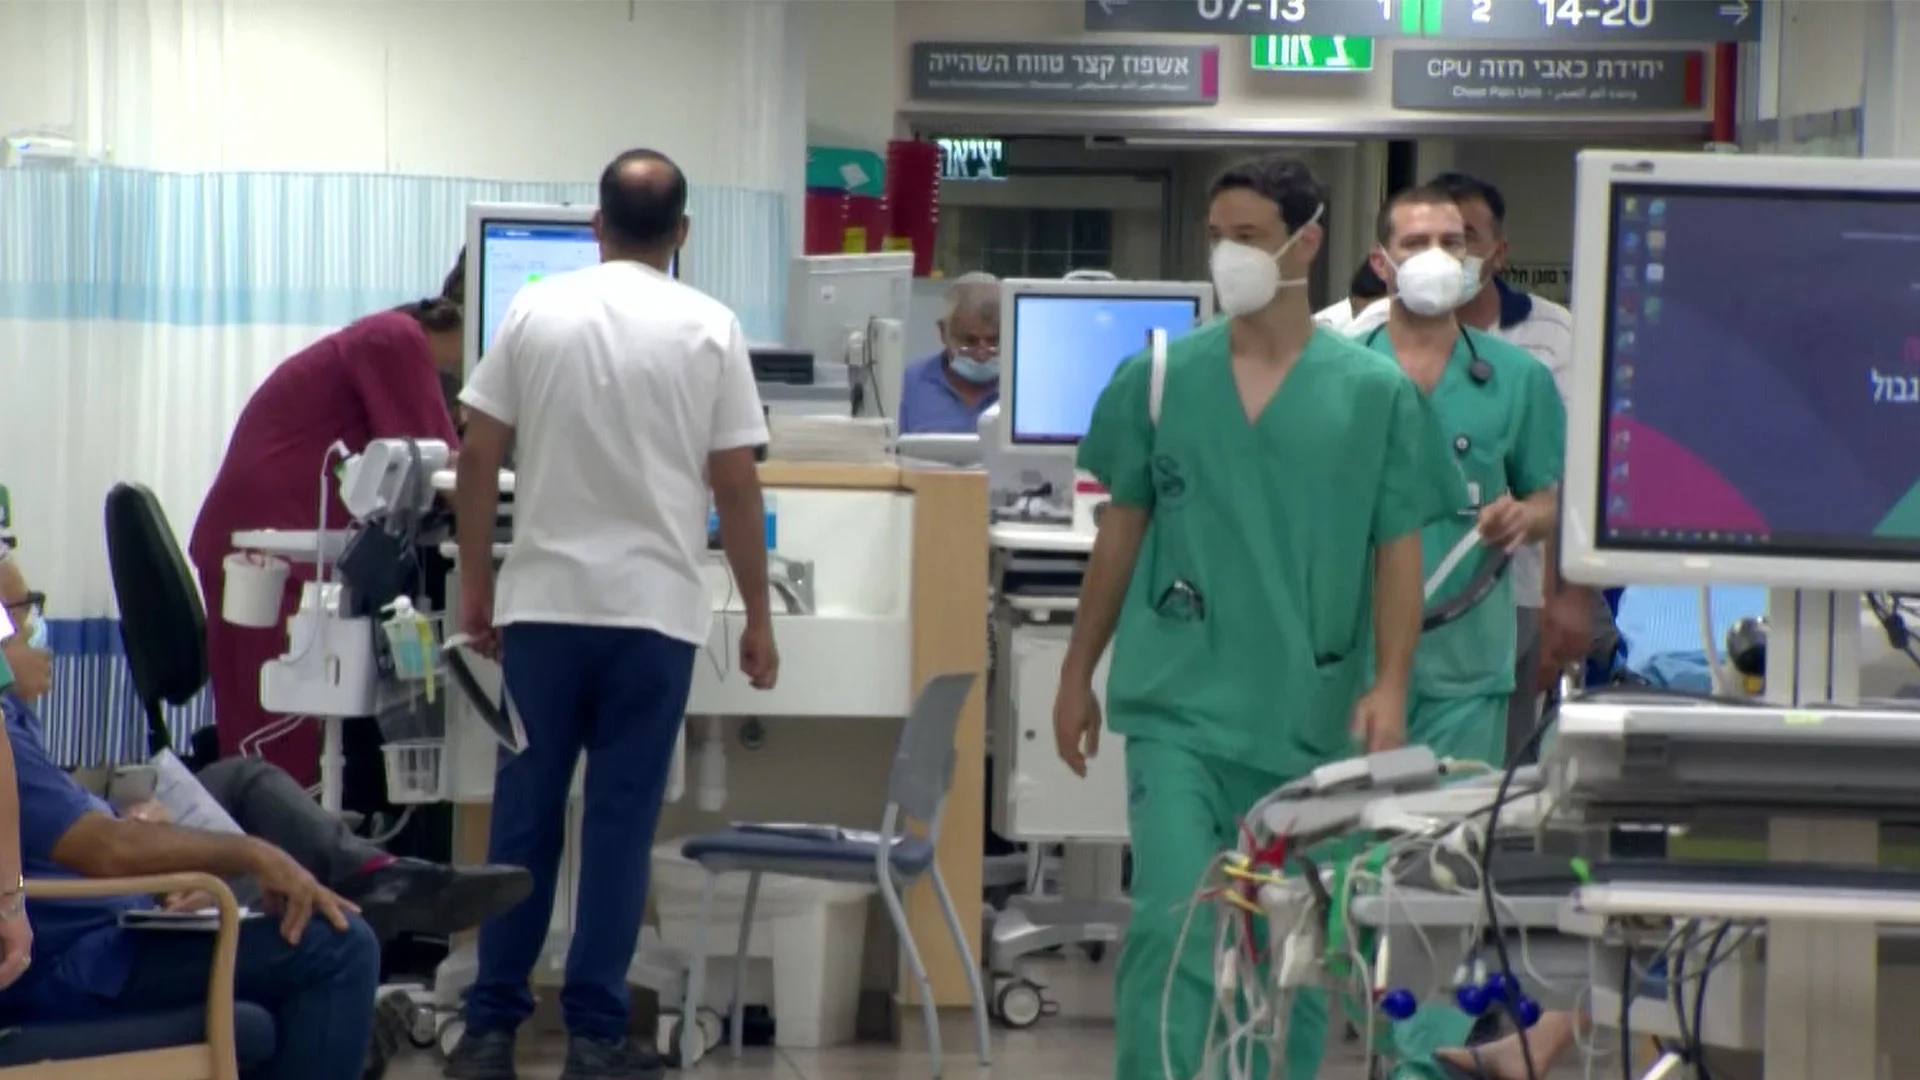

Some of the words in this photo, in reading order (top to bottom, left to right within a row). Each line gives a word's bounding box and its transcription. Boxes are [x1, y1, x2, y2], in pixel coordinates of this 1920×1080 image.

[1537, 0, 1653, 27] 14-20
[929, 53, 1010, 73] השהייה
[1016, 54, 1064, 74] טווח
[1070, 55, 1115, 80] קצר
[1122, 56, 1189, 75] אשפוז
[1427, 58, 1471, 77] CPU
[1479, 59, 1524, 78] חזה
[1534, 59, 1589, 79] כאבי
[1595, 59, 1665, 80] יחידת
